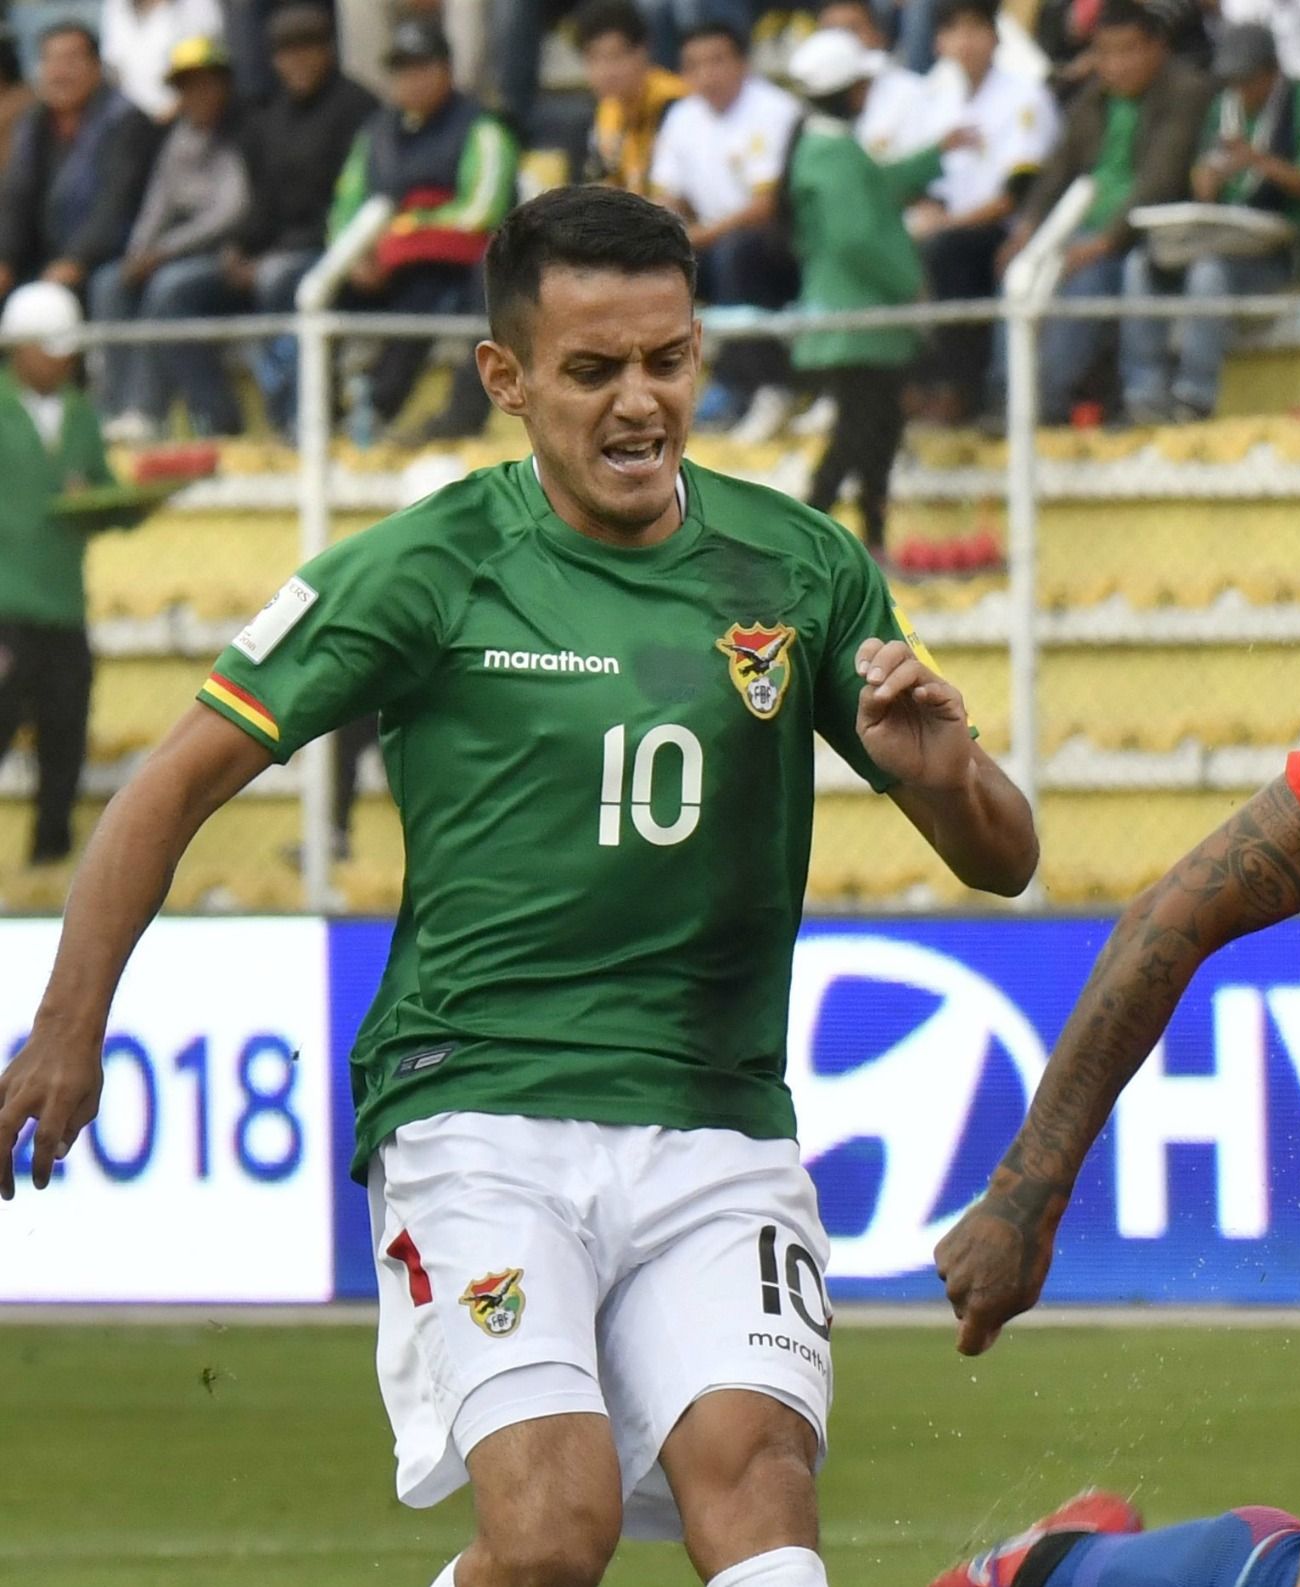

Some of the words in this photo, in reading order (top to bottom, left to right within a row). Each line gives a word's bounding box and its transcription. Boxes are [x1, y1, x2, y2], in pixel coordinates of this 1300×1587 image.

[483, 649, 620, 674] marathon
[598, 723, 704, 846] 10
[758, 1225, 831, 1342] 10
